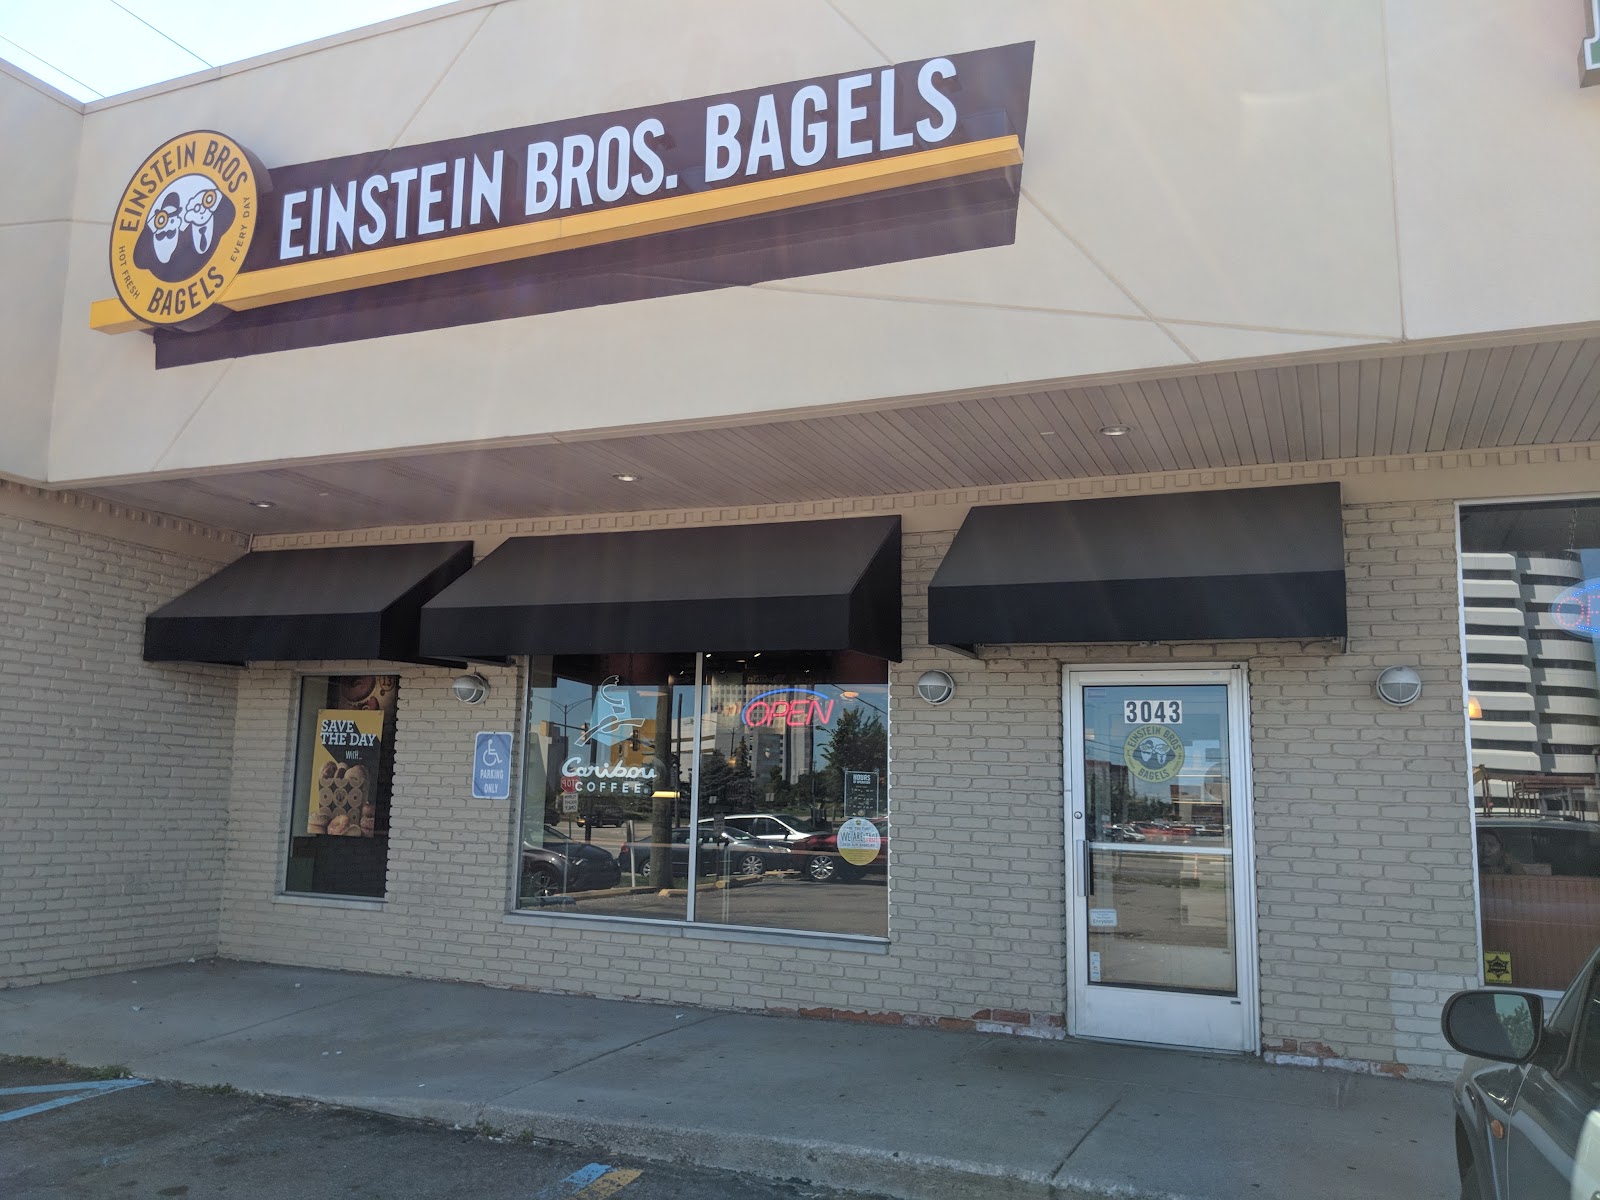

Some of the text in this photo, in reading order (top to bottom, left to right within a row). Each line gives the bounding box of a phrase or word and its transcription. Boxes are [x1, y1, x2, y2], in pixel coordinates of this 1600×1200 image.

[280, 57, 957, 260] EINSTEIN BROS. BAGELS
[120, 140, 247, 232] EINSTEIN BROS
[230, 225, 248, 263] EVERY
[118, 245, 140, 300] HOT FRESH
[147, 266, 225, 316] BAGELS
[745, 699, 834, 727] OPEN
[1126, 701, 1180, 723] 3043
[321, 719, 354, 733] SAVE
[320, 732, 377, 747] THE DAY
[1128, 726, 1181, 750] EINSTEIN BROS
[480, 769, 504, 779] PARKING
[561, 756, 657, 779] Caribou
[1138, 768, 1169, 780] BAGELS
[484, 783, 499, 793] ONLY
